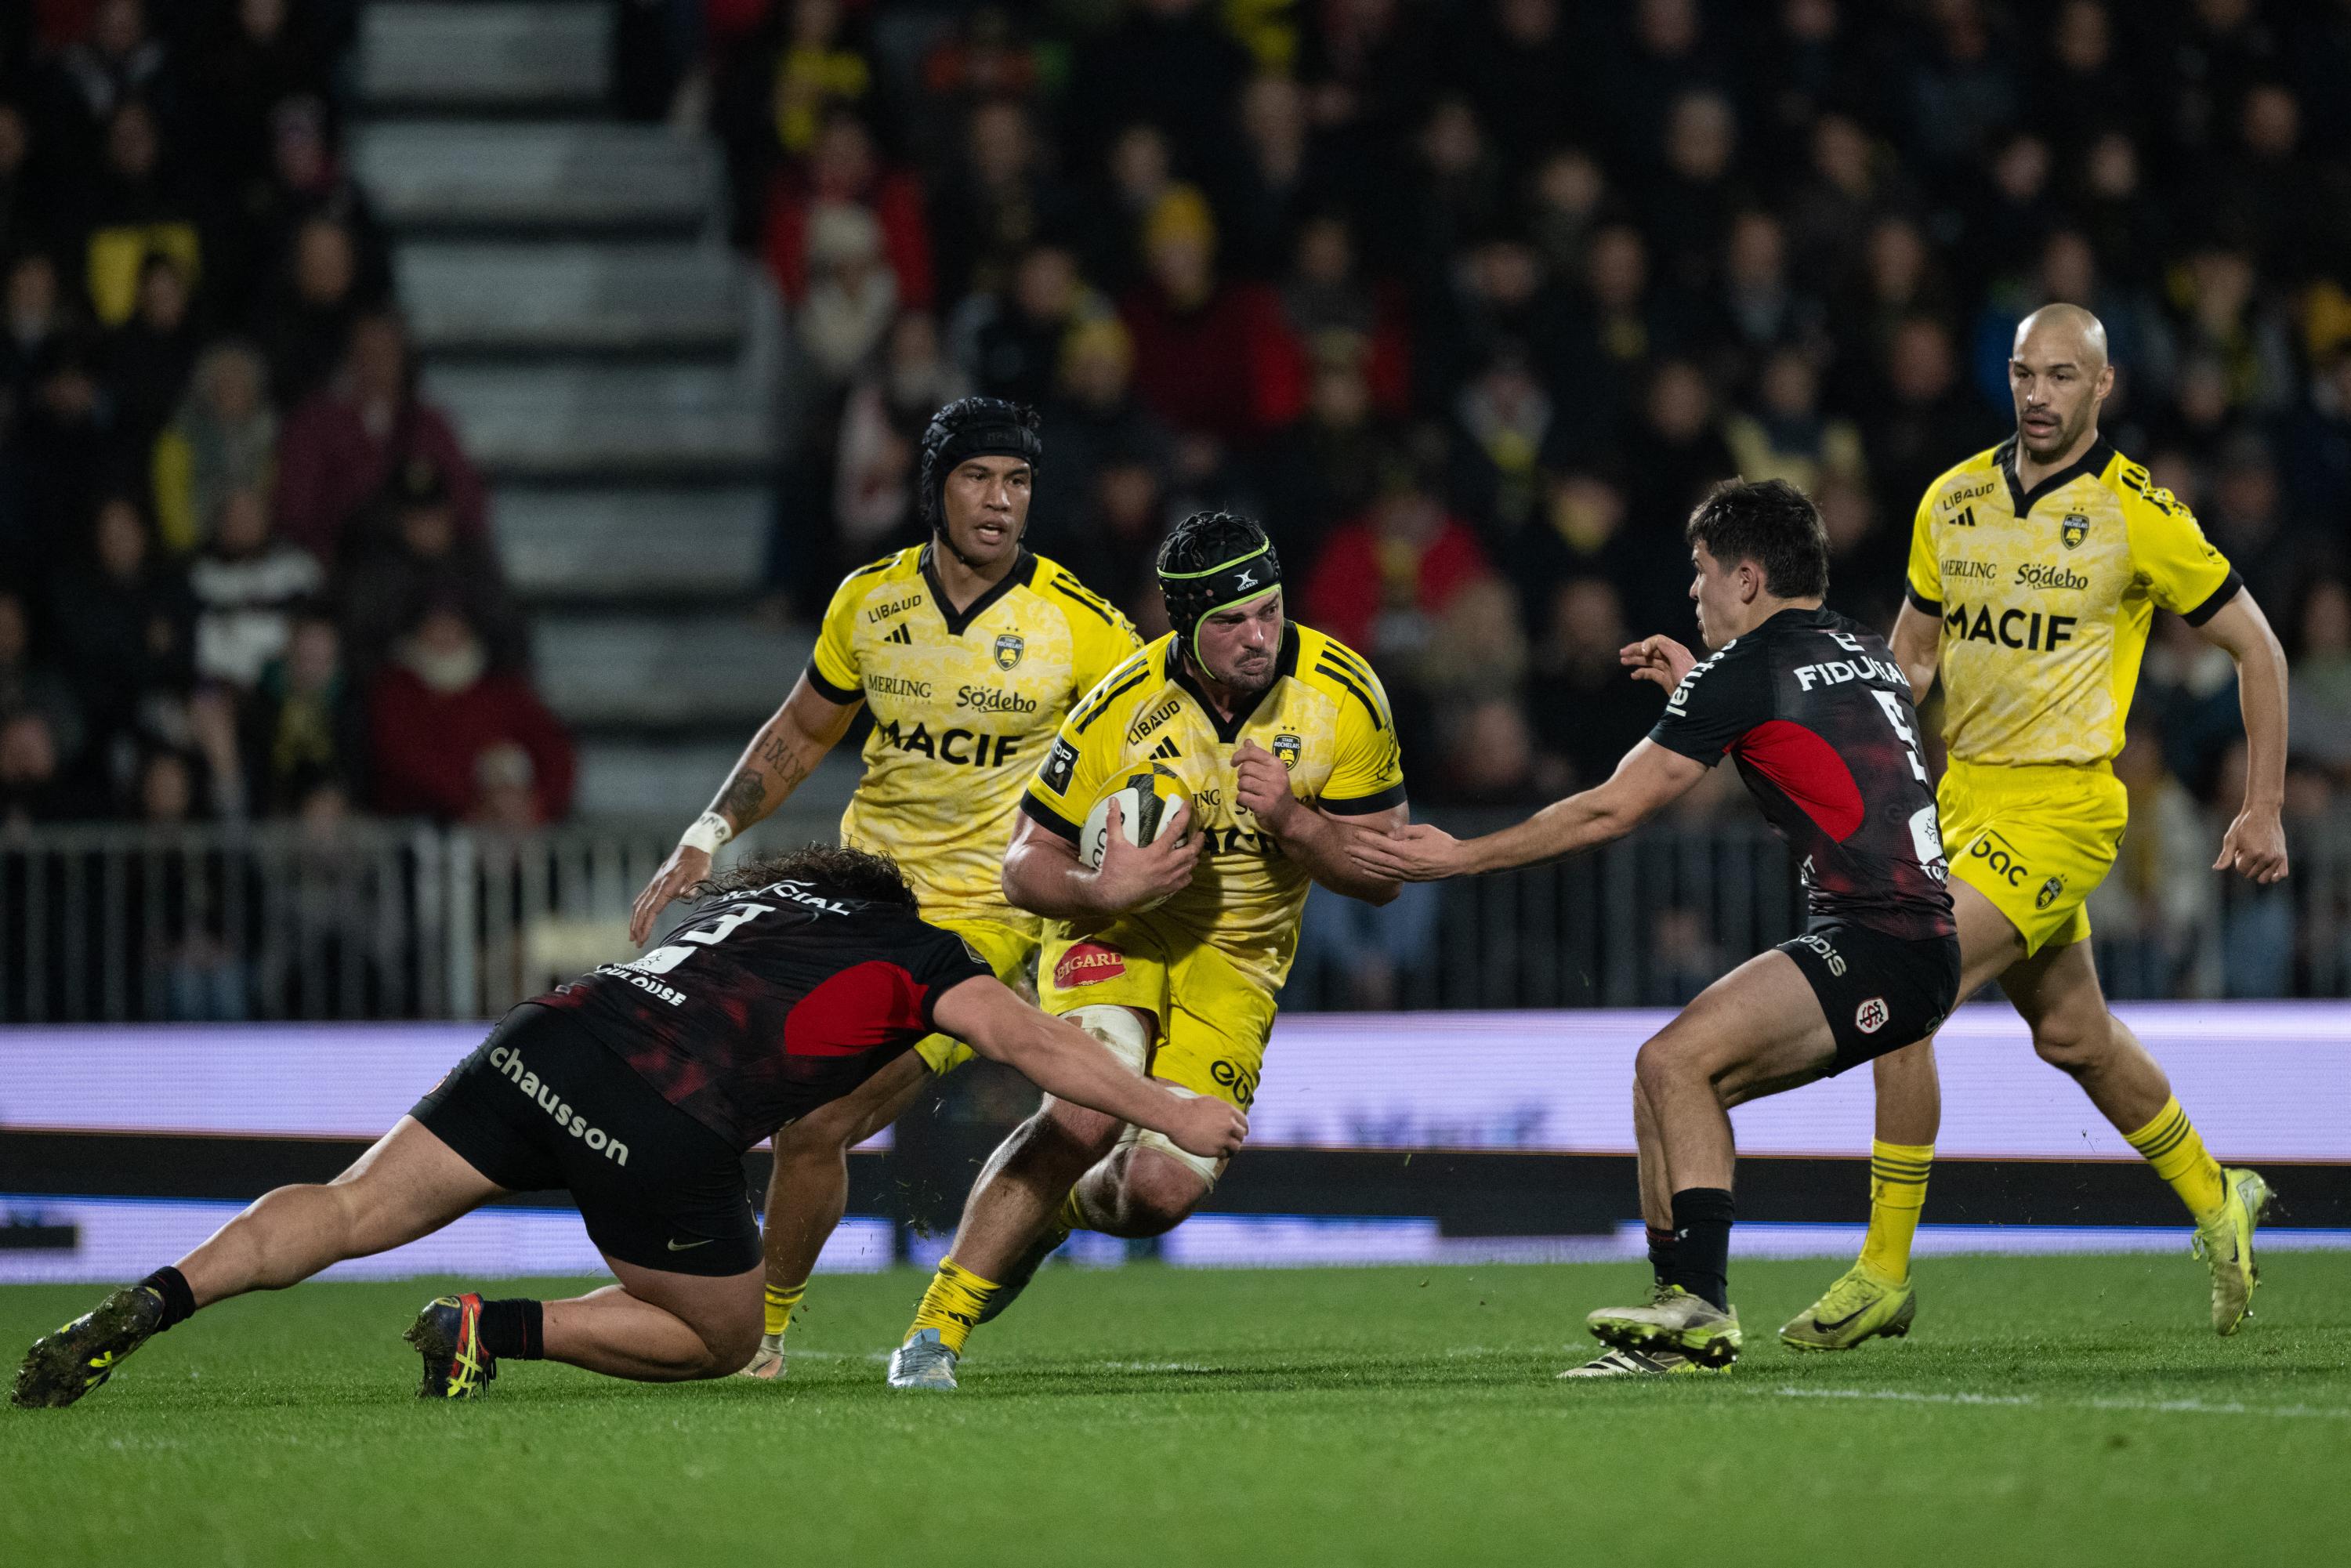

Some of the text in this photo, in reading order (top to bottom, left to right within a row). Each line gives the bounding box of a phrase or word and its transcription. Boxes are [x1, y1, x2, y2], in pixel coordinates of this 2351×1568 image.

[1943, 483, 1994, 511] LIBAUD
[1941, 560, 1998, 579] MERLING
[868, 595, 922, 624] LIBAUD
[1943, 603, 2078, 652] MACIF
[868, 674, 932, 698] MERLING
[1128, 700, 1181, 747] LIBAUD
[876, 719, 1026, 769] MACIF
[1056, 952, 1124, 982] BIGARD
[489, 1046, 629, 1167] chausson
